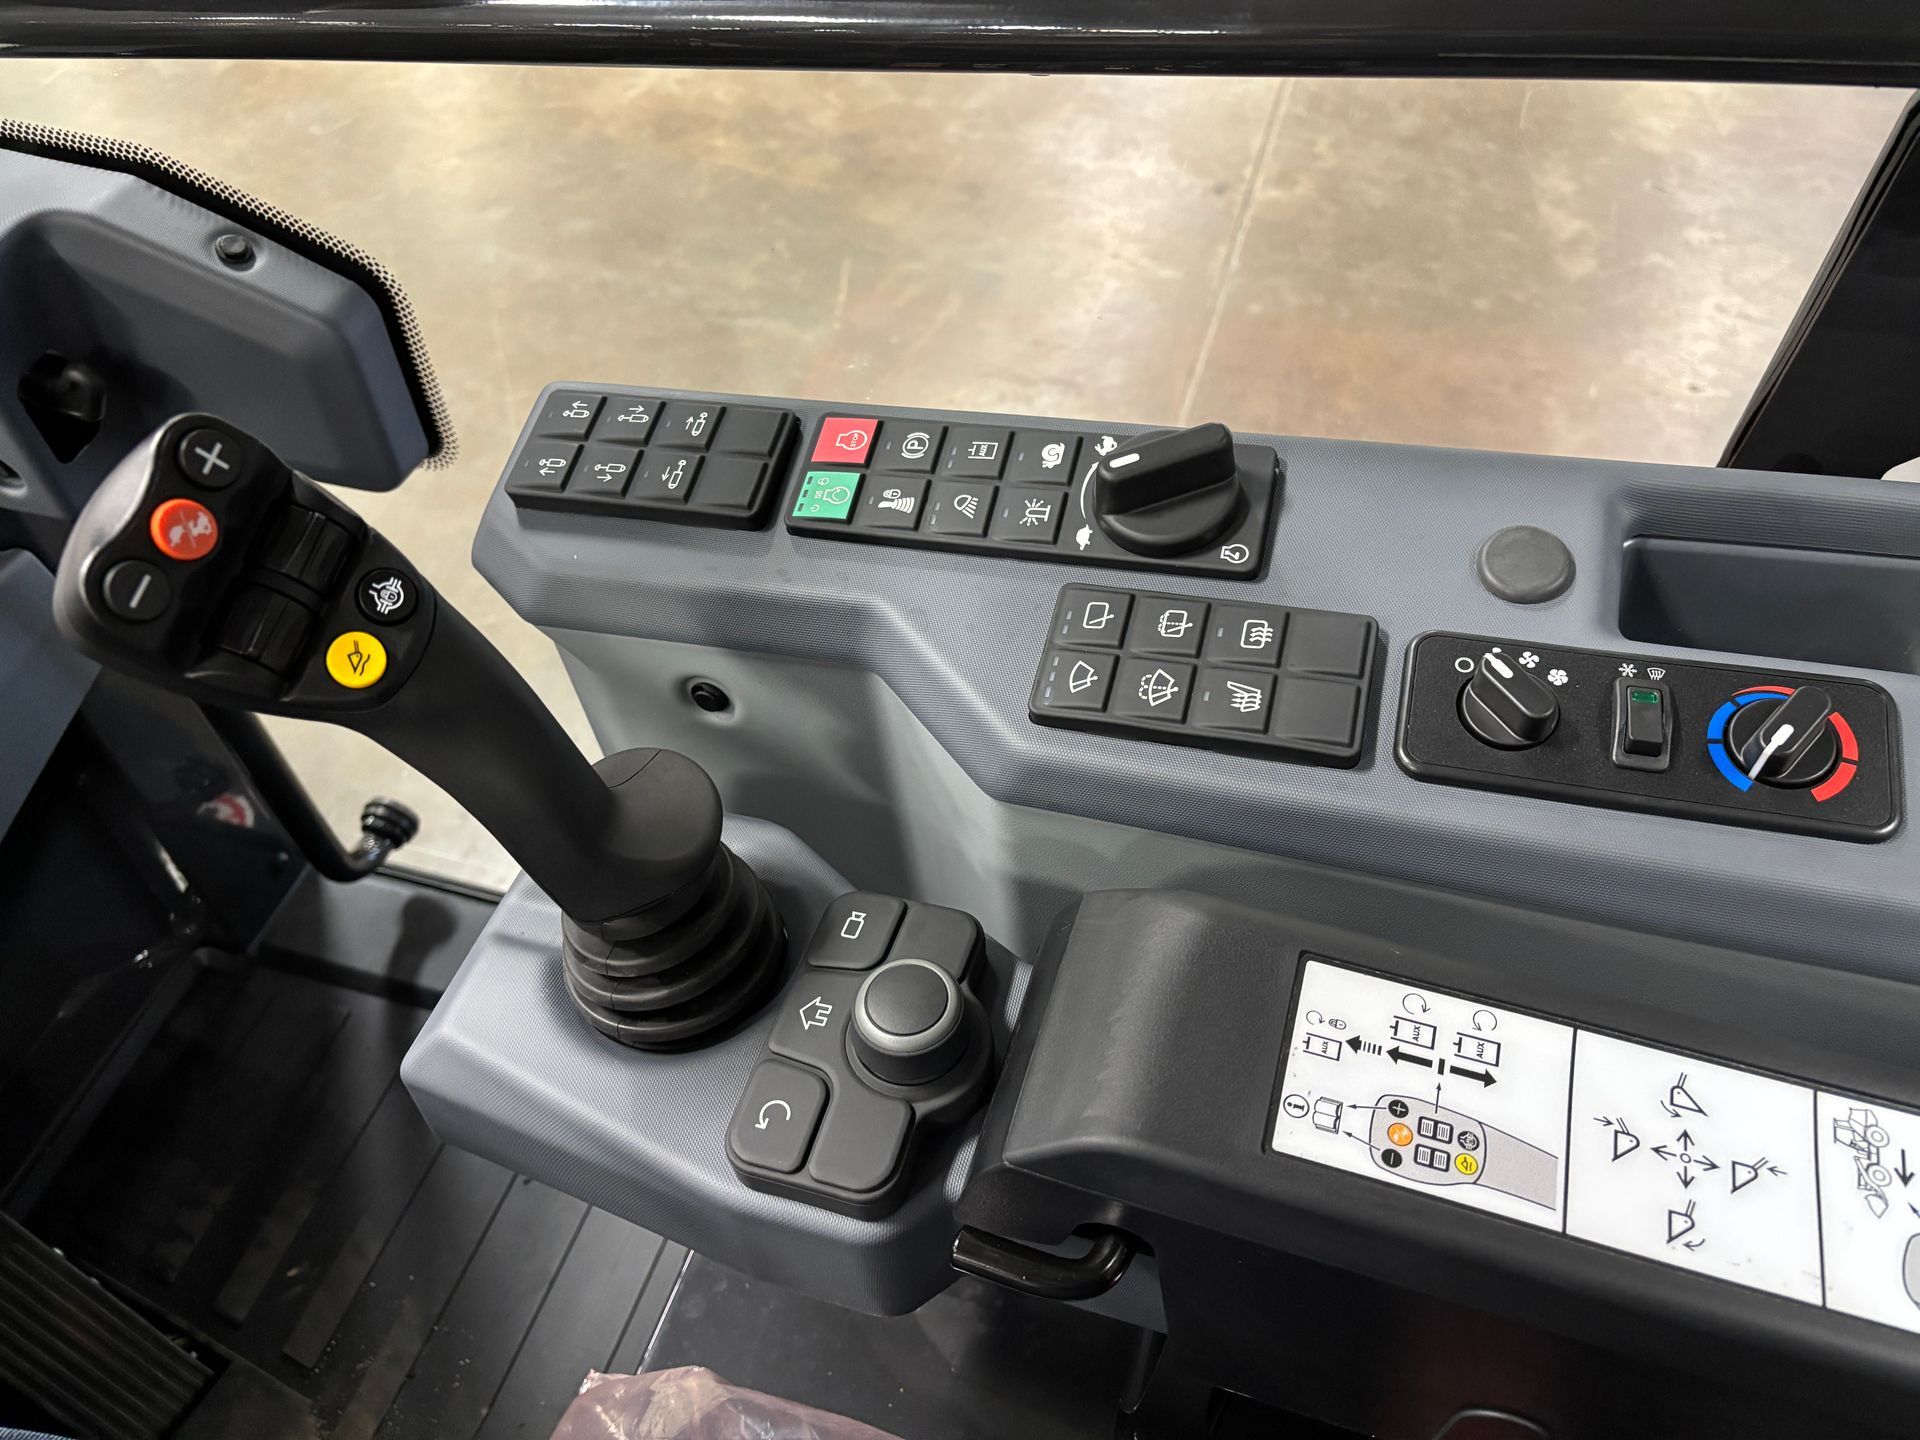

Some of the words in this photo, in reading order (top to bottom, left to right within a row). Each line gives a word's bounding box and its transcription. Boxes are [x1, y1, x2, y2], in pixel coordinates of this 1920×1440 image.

[850, 433, 859, 447] STOP
[907, 440, 924, 449] P
[979, 445, 988, 456] AUX
[1412, 1025, 1421, 1042] AUX
[1321, 1041, 1329, 1055] AUX
[1476, 1042, 1485, 1059] AUX
